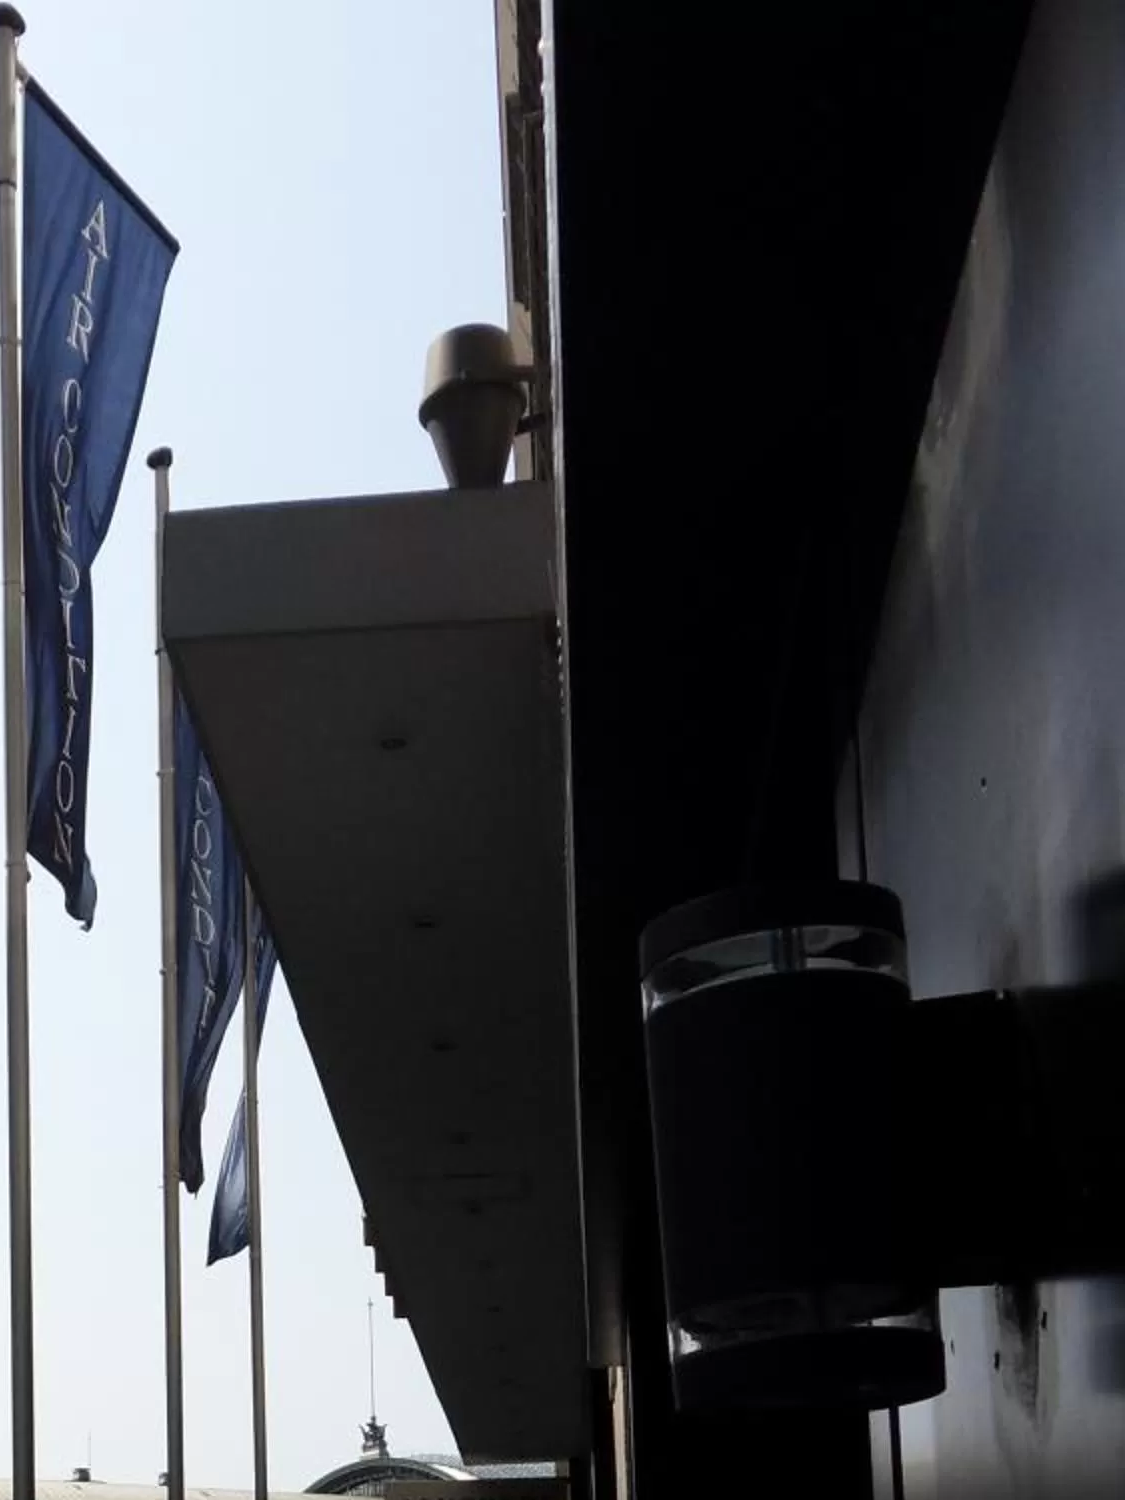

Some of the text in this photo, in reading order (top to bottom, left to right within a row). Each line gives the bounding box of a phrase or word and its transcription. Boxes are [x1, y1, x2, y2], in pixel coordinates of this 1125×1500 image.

[49, 199, 110, 875] AIR CONDITION
[189, 774, 216, 1039] CONDIT
